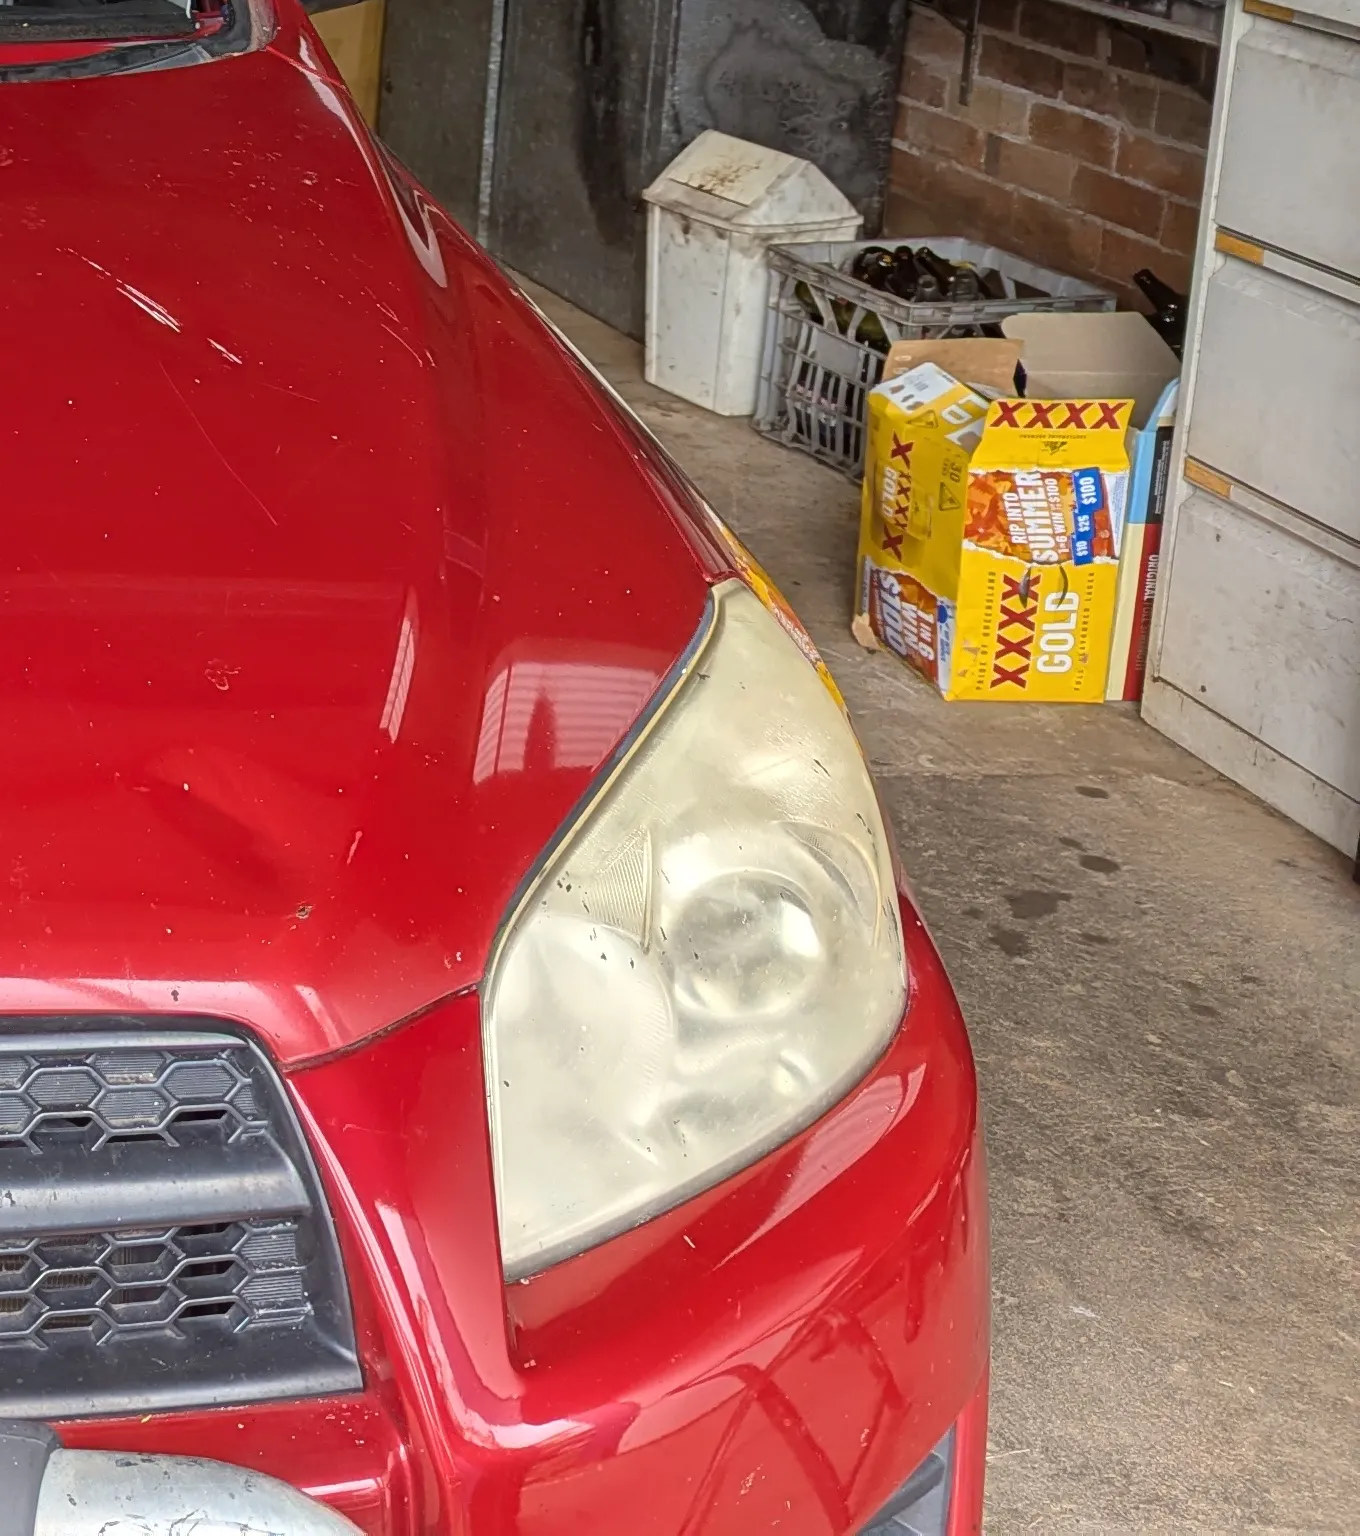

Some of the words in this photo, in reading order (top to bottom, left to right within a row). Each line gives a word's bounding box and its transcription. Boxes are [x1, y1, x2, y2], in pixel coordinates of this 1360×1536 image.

[989, 401, 1128, 430] XXXX
[949, 462, 962, 483] 30
[1044, 477, 1061, 503] $100
[1078, 476, 1098, 505] $100
[1002, 492, 1023, 521] INTO
[1015, 470, 1060, 563] SUMMER
[1009, 524, 1029, 544] RIP
[1051, 512, 1066, 534] WIN
[1077, 515, 1091, 533] $25
[1075, 540, 1089, 557] $10
[1143, 554, 1159, 601] ORIGINAL
[880, 571, 907, 656] $100
[982, 571, 997, 637] QUEENSLAND
[901, 600, 920, 650] WIN
[919, 622, 932, 643] IN
[989, 574, 1042, 689] XXXX
[1037, 592, 1080, 673] GOLD
[1073, 669, 1084, 691] FULL
[1083, 572, 1095, 601] LAGER
[918, 641, 935, 661] 6
[980, 644, 988, 655] OF
[975, 662, 988, 691] PRIDE
